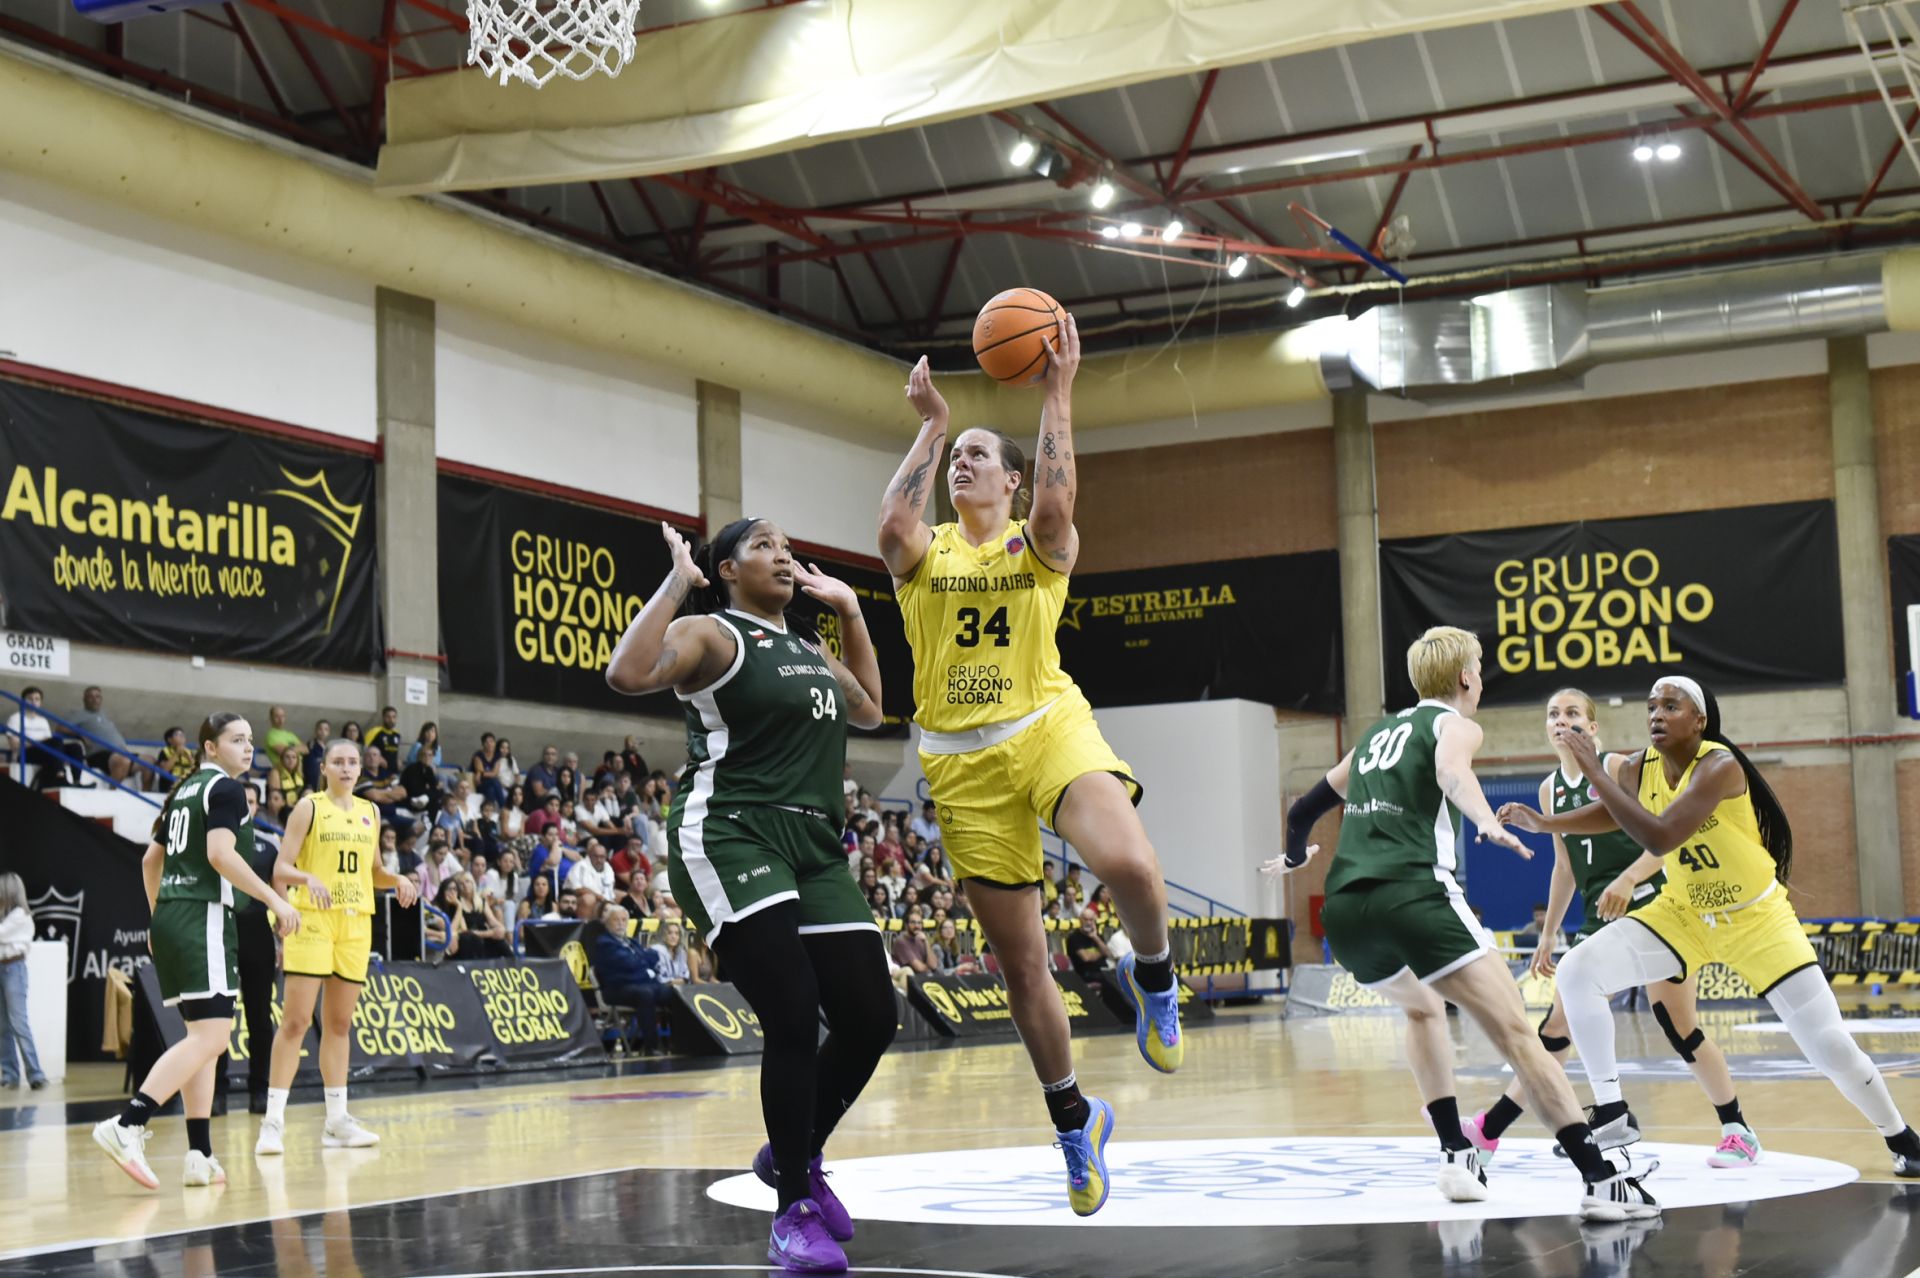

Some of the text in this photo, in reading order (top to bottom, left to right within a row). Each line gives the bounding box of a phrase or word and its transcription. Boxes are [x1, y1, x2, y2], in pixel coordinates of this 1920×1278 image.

[1, 464, 296, 567] Alcantarilla
[54, 544, 266, 599] donde la huerta nace
[511, 529, 615, 589] GRUPO
[1494, 548, 1660, 599] GRUPO
[931, 572, 1036, 593] HOZONO JAIRIS
[1091, 584, 1237, 617] ESTRELLA
[1496, 583, 1715, 636] HOZONO
[956, 606, 1010, 648] 34
[1124, 608, 1203, 625] DE LEVANTE
[6, 632, 55, 652] GRADA
[514, 618, 621, 671] GLOBA
[1497, 625, 1683, 674] GLOBAL
[10, 651, 51, 669] OESTE
[948, 665, 1000, 678] GRUPO
[947, 691, 1004, 704] GLOBAL
[948, 678, 1013, 691] HOZONO
[810, 687, 838, 720] 34
[1358, 722, 1413, 775] 30
[167, 806, 190, 856] 90
[337, 850, 358, 874] 10
[1580, 838, 1593, 865] 7
[1679, 844, 1720, 872] 40
[751, 864, 771, 878] UMCS
[1686, 881, 1726, 893] GRUPO
[360, 974, 424, 1002] RUPO
[470, 967, 540, 996] GRUPO
[356, 1027, 455, 1056] GLOBAL
[491, 1015, 571, 1045] GLOBAL
